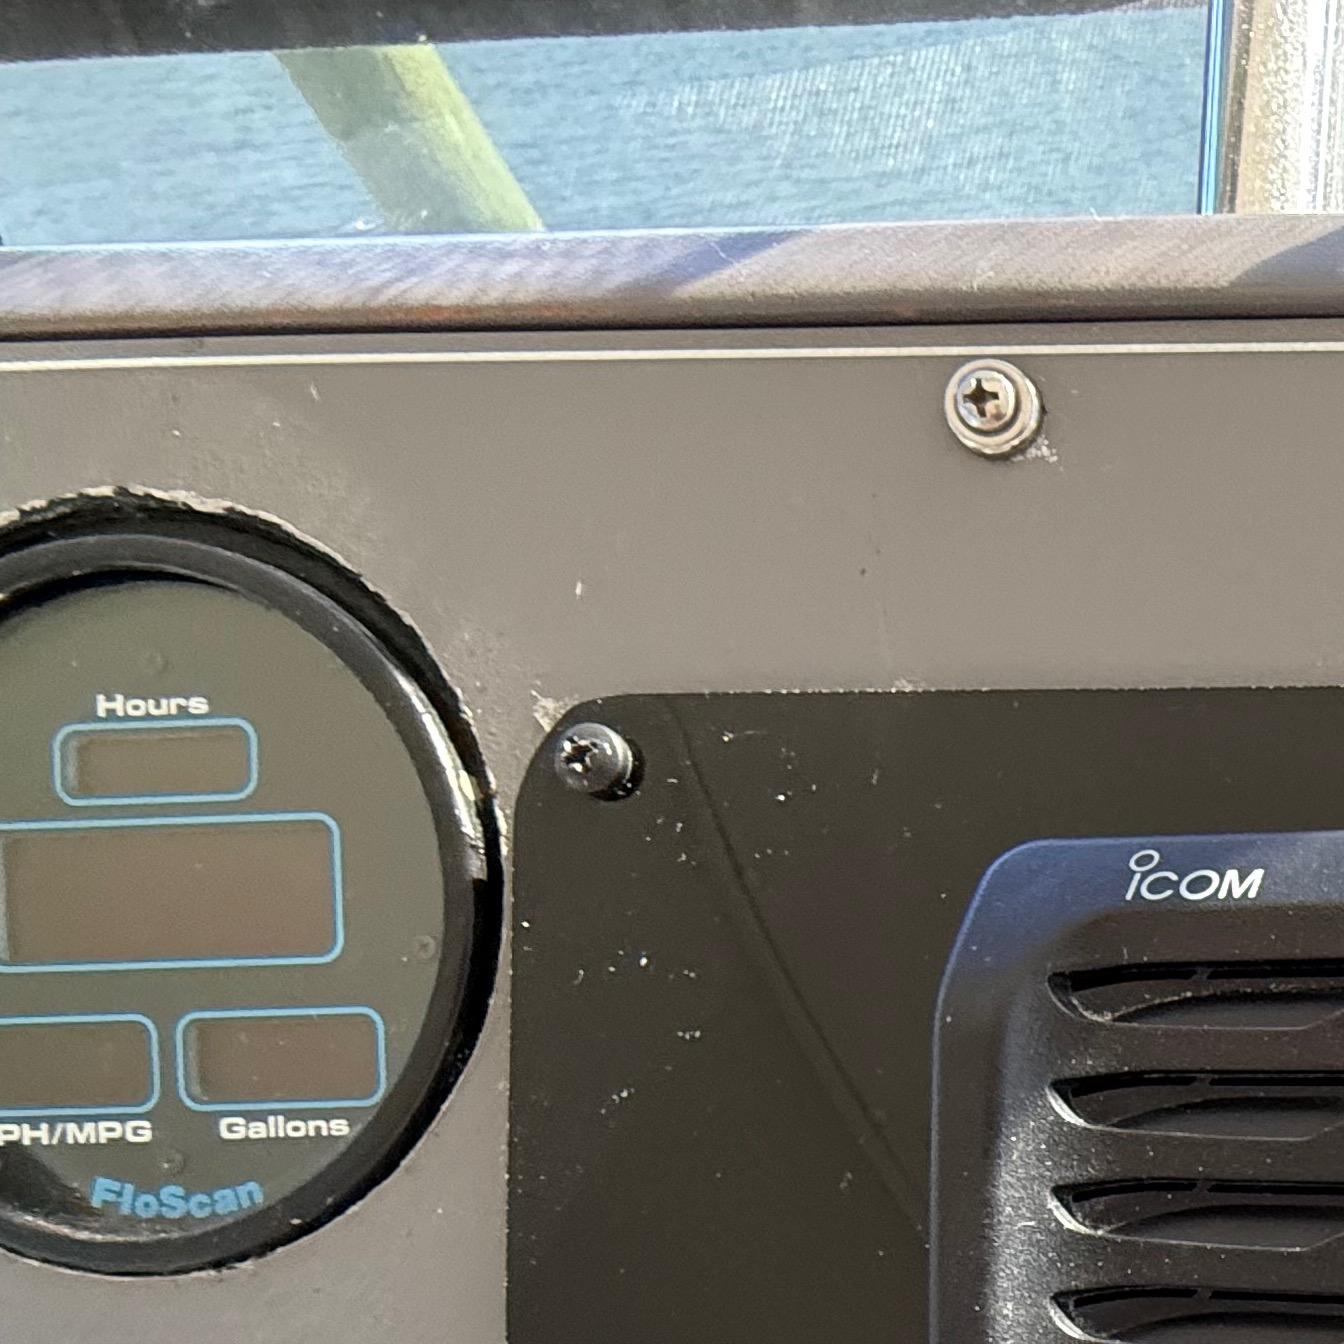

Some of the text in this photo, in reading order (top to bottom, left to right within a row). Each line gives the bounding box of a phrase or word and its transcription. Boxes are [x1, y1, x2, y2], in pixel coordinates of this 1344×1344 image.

[96, 694, 210, 718] Hours
[218, 1115, 351, 1140] Gallons
[91, 1177, 265, 1219] FloScan
